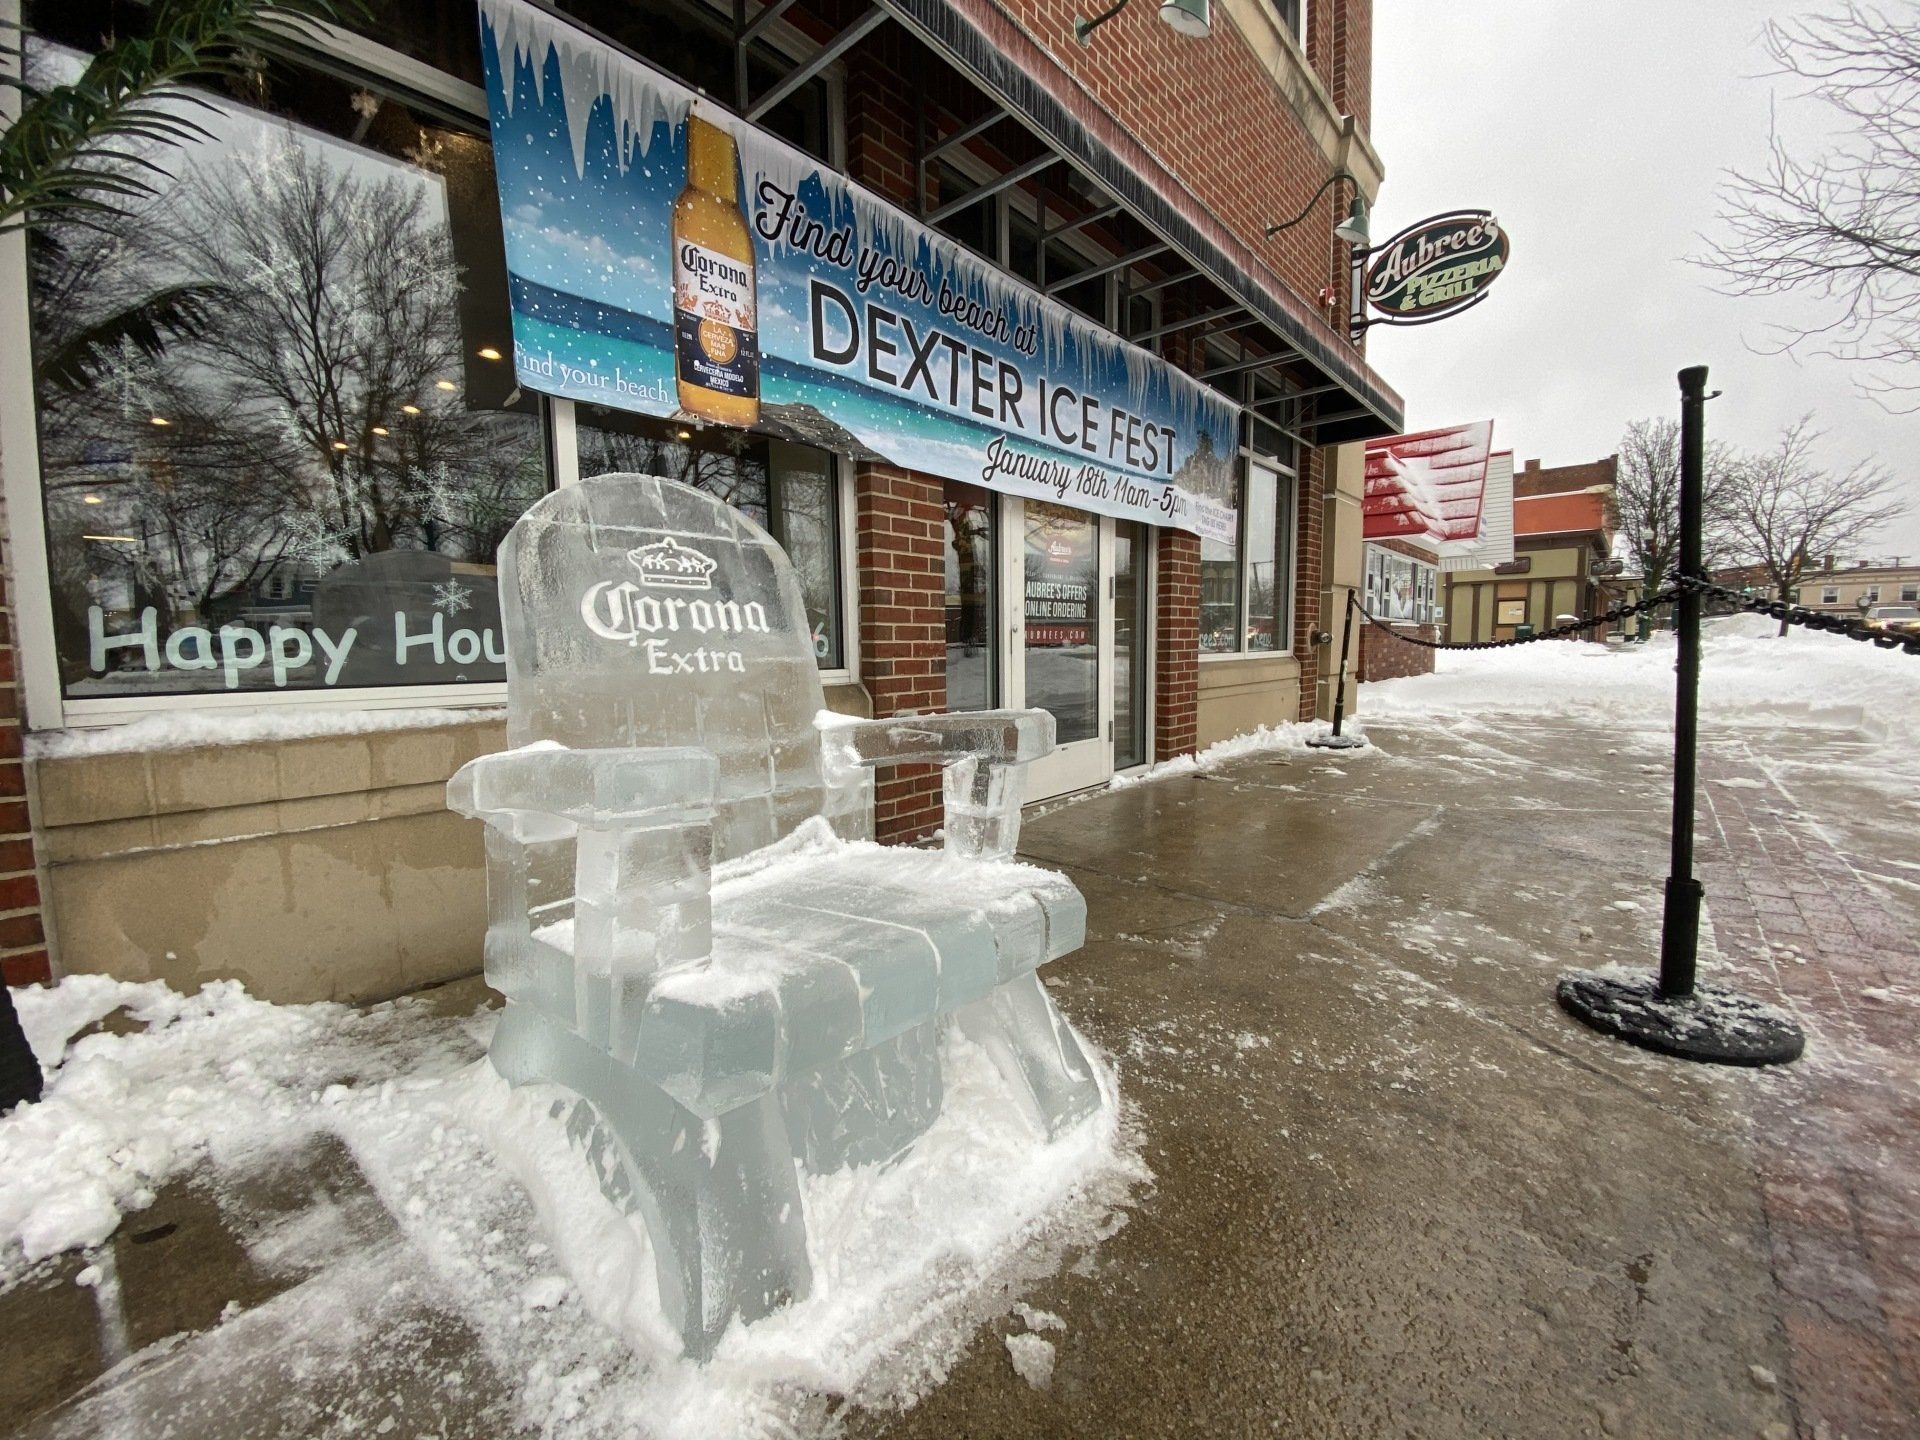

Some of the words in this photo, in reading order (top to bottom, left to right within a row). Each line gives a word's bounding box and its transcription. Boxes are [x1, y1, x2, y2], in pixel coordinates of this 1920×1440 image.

[681, 245, 748, 288] Corona
[755, 180, 853, 268] Find
[857, 247, 932, 305] your
[938, 278, 1010, 343] beach
[1014, 324, 1038, 356] at
[1369, 216, 1499, 300] Aubree's
[1406, 255, 1504, 295] PIZZERIA
[700, 273, 737, 302] Extra
[1400, 294, 1416, 312] &
[1418, 278, 1478, 307] GRILL
[702, 330, 734, 347] CERVEZA
[514, 340, 553, 377] Find
[560, 365, 609, 388] your
[615, 368, 674, 404] beach.
[810, 279, 1024, 429] DEXTER
[1039, 378, 1099, 453] ICE
[1109, 407, 1176, 474] FEST
[982, 435, 1071, 499] January
[1076, 464, 1110, 499] 18th
[1025, 600, 1051, 617] ONLINE
[1053, 602, 1087, 618] ORDERING
[1026, 581, 1061, 600] AUBREE'S
[1062, 584, 1087, 601] OFFERS
[580, 581, 770, 647] Corona
[88, 605, 358, 689] Happy
[643, 638, 746, 675] Extra
[812, 621, 829, 658] 6
